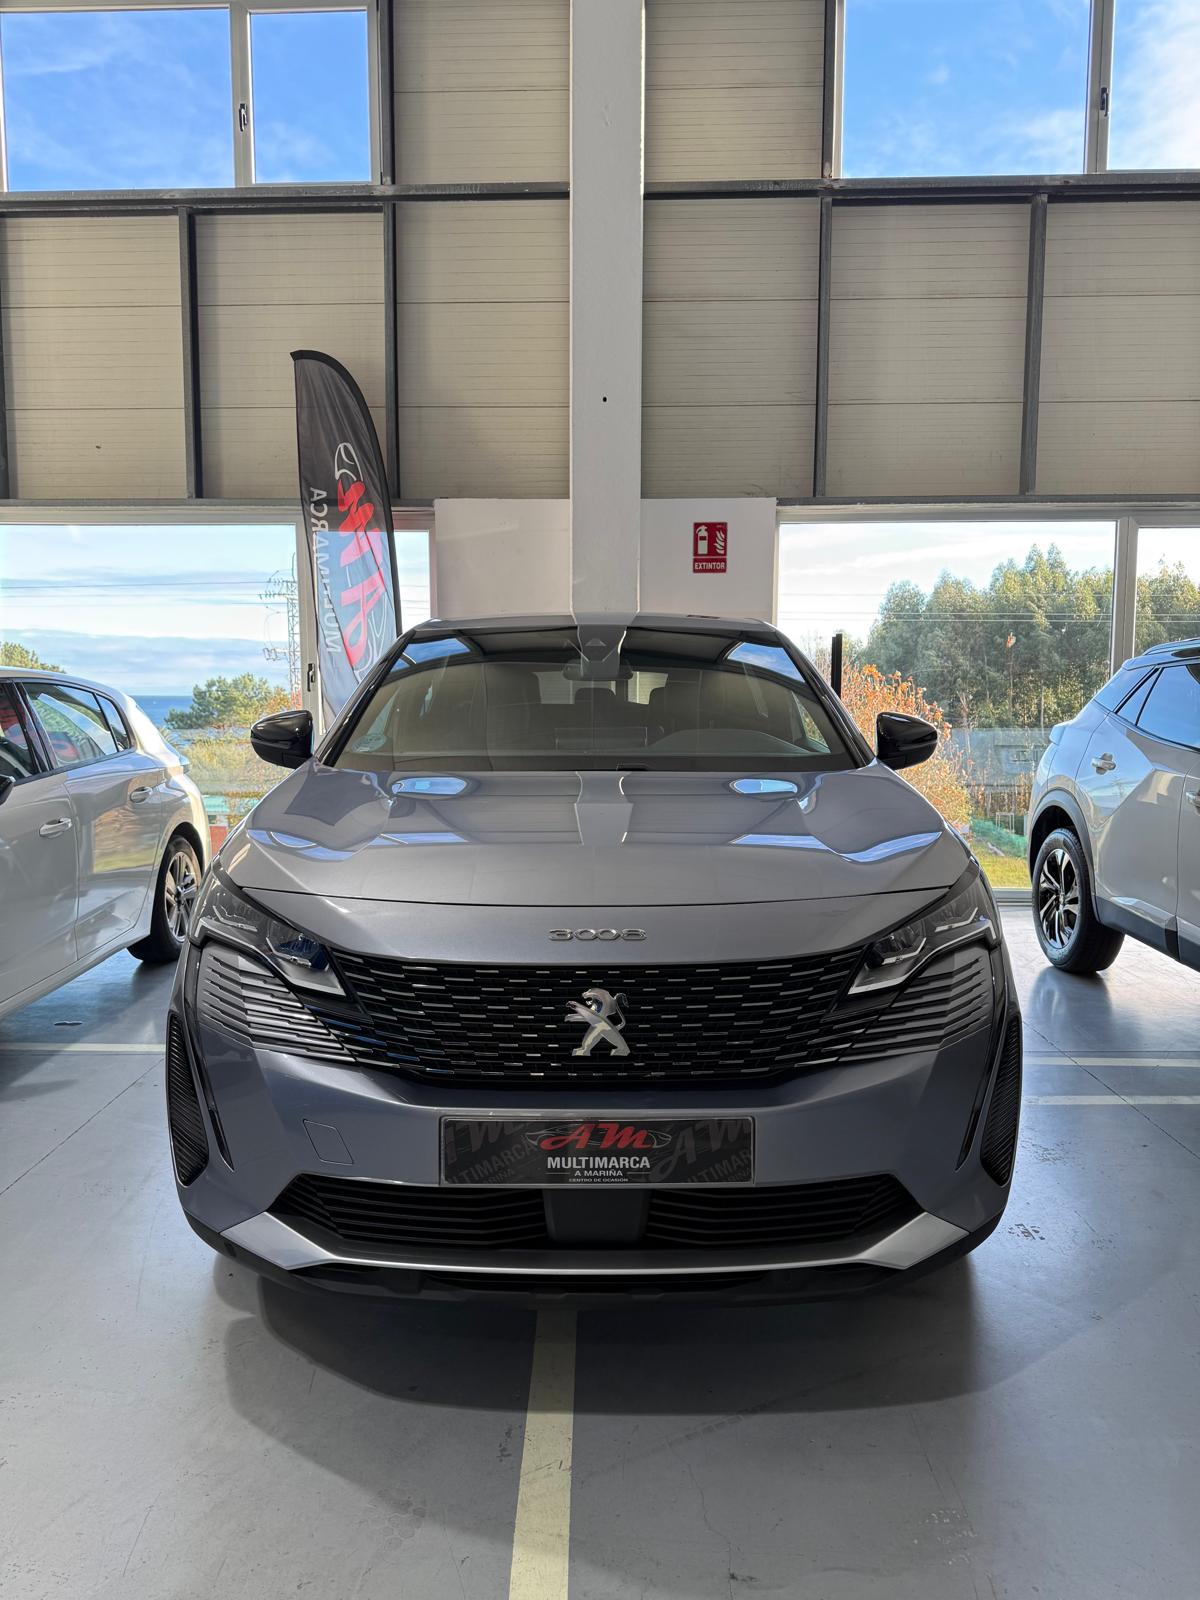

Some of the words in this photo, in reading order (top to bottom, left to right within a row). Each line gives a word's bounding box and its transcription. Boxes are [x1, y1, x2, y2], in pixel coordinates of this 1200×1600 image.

[694, 562, 725, 570] EXTINTOR
[548, 928, 648, 942] 3008
[547, 1156, 650, 1168] MULTIMARCA
[584, 1168, 624, 1177] MARIÑA
